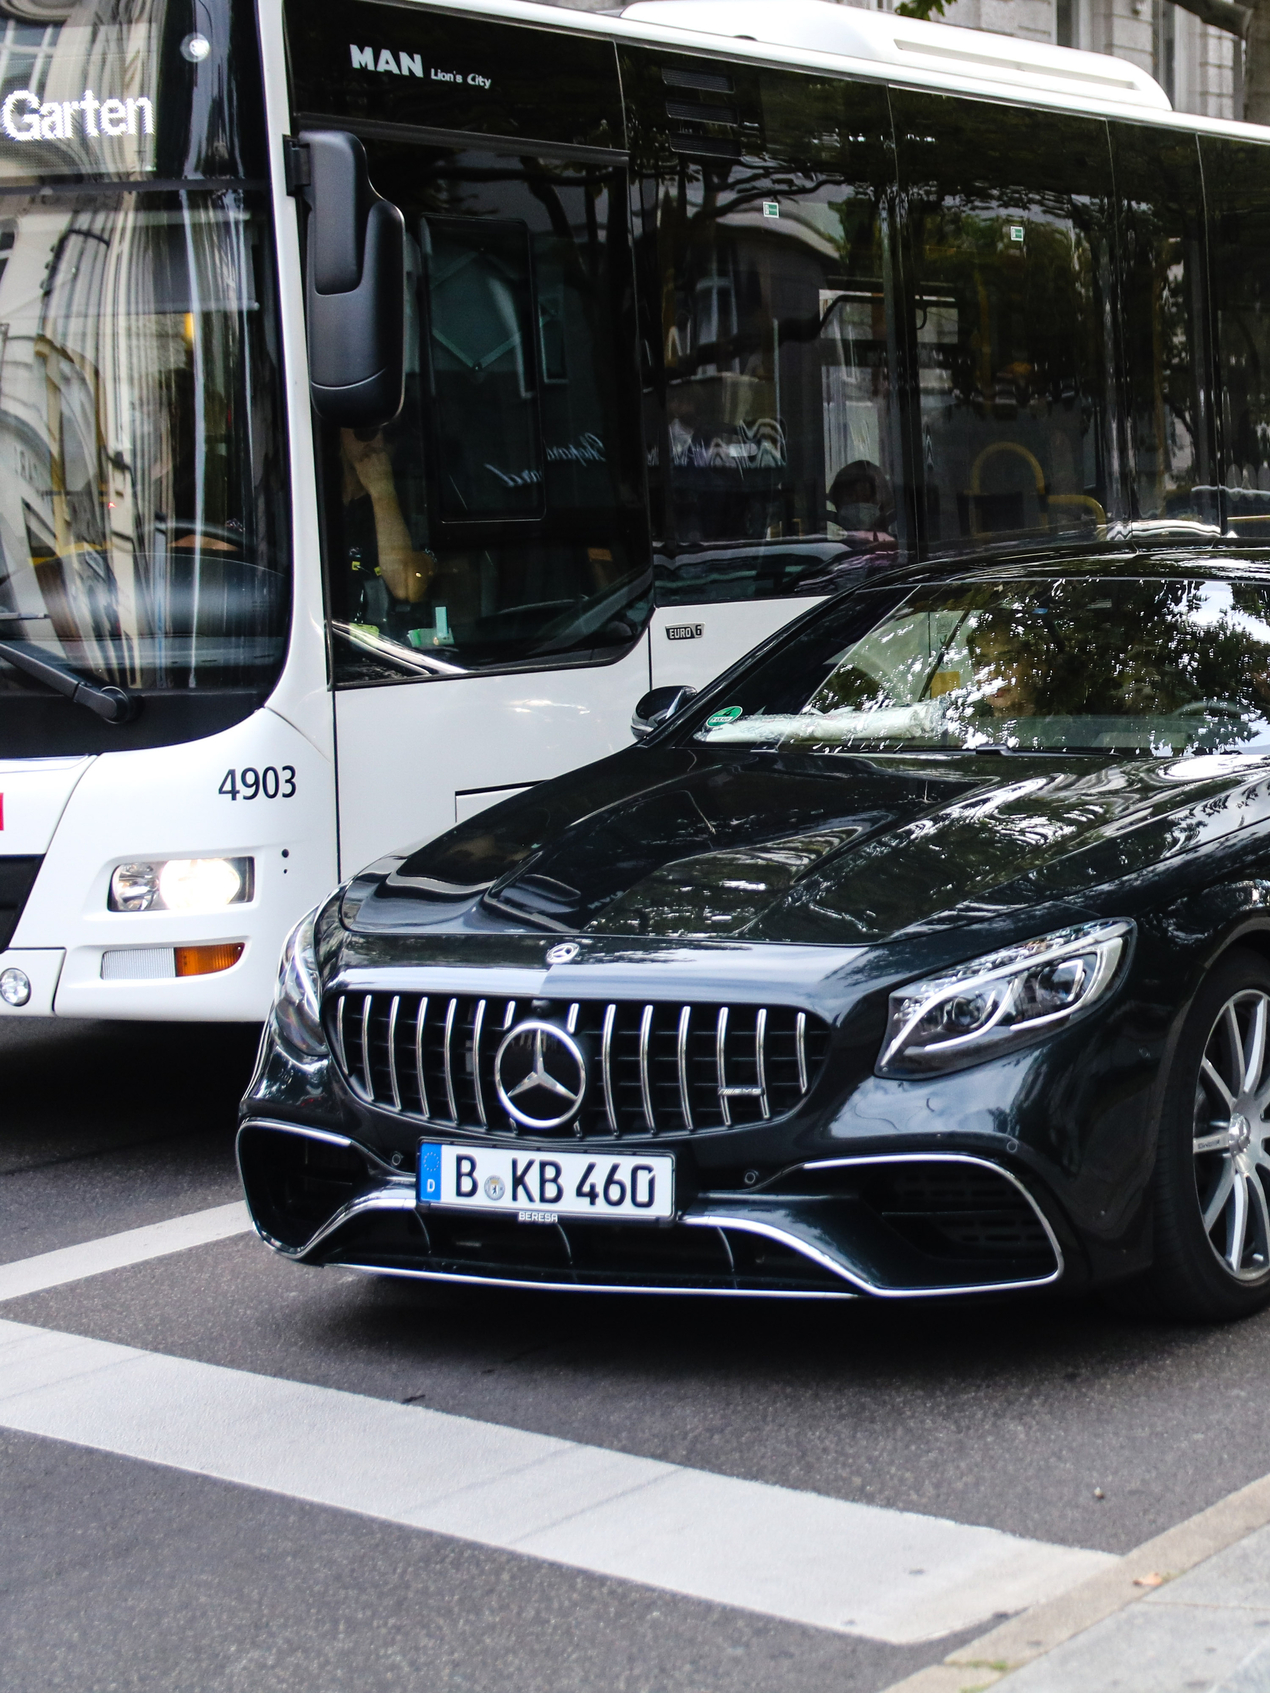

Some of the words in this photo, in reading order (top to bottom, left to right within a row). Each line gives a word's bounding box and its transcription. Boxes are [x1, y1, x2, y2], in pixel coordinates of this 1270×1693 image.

[349, 43, 424, 78] MAN
[430, 67, 463, 84] Lion's
[466, 72, 492, 89] City
[0, 89, 156, 142] Garten
[669, 627, 692, 639] EURO
[695, 624, 702, 636] 6
[218, 764, 297, 801] 4903
[426, 1179, 436, 1192] D
[455, 1152, 479, 1198] B
[511, 1157, 565, 1204] KB
[575, 1161, 656, 1209] 460
[518, 1211, 558, 1223] BERESA
